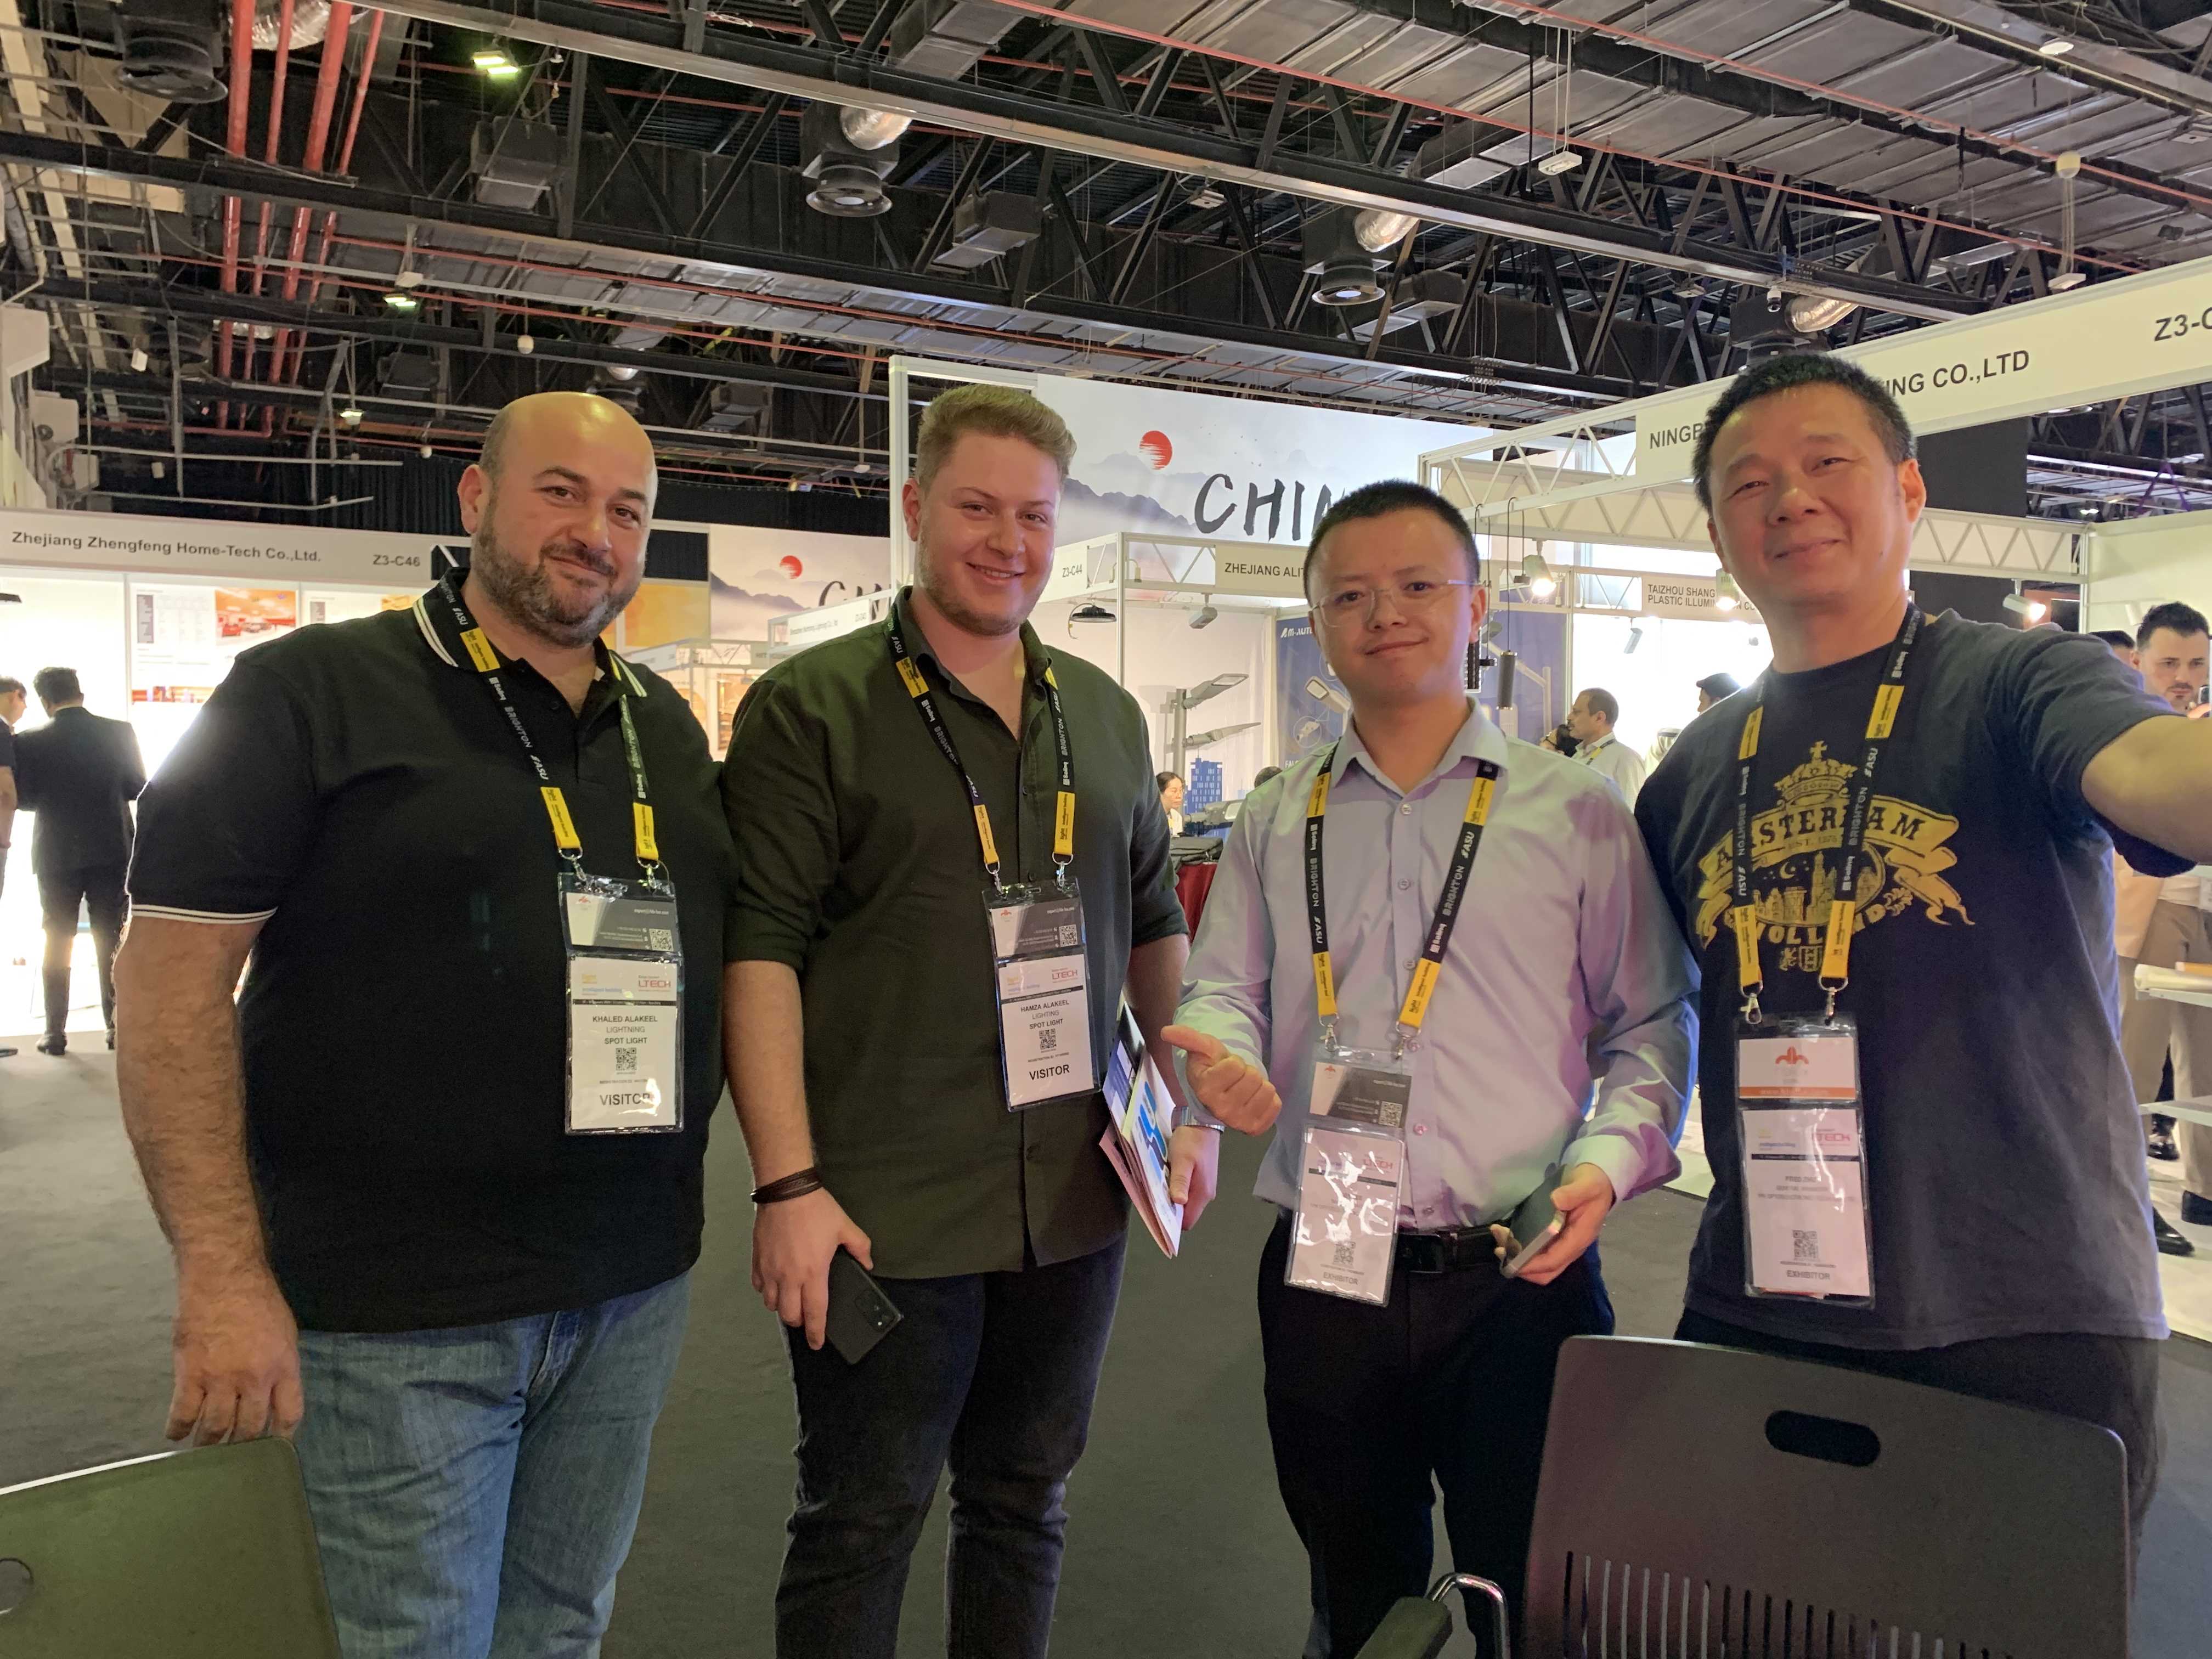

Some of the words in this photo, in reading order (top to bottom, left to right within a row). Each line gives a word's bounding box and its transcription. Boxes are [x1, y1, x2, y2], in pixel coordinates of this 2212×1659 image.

[1650, 423, 1703, 449] NINGB
[1885, 373, 1924, 397] ING
[1933, 349, 2029, 388] CO.,LTD
[12, 532, 82, 549] Zhejiang
[87, 536, 171, 555] Zhengfeng
[177, 543, 260, 558] Home-Tech
[373, 554, 421, 567] Z3-C46
[1062, 564, 1082, 578] Z3-C44
[1224, 562, 1280, 576] ZHEJIANG
[1648, 584, 1684, 595] TAIZHOU
[1647, 595, 1683, 606] PLASTIC
[504, 706, 533, 748] BRIGHTON
[1058, 718, 1068, 756] BRIGHTON
[1848, 787, 1868, 845] BRIGHTON
[1866, 747, 1878, 769] ASU
[1737, 803, 1746, 856] BRIGHTON
[1717, 805, 1926, 871] ASTERAM
[1310, 857, 1319, 907] BRIGHTON
[1442, 865, 1465, 917] BRIGHTON
[1463, 831, 1475, 851] ASU
[1738, 874, 1747, 896] ASU
[1052, 970, 1078, 980] LTECH
[1043, 1000, 1069, 1009] ALAKEEL
[1032, 1010, 1059, 1019] LIGHTING
[1046, 1019, 1063, 1027] LIGHT
[1029, 1064, 1070, 1080] VISITOR
[1786, 1269, 1830, 1280] EXHIBITOR
